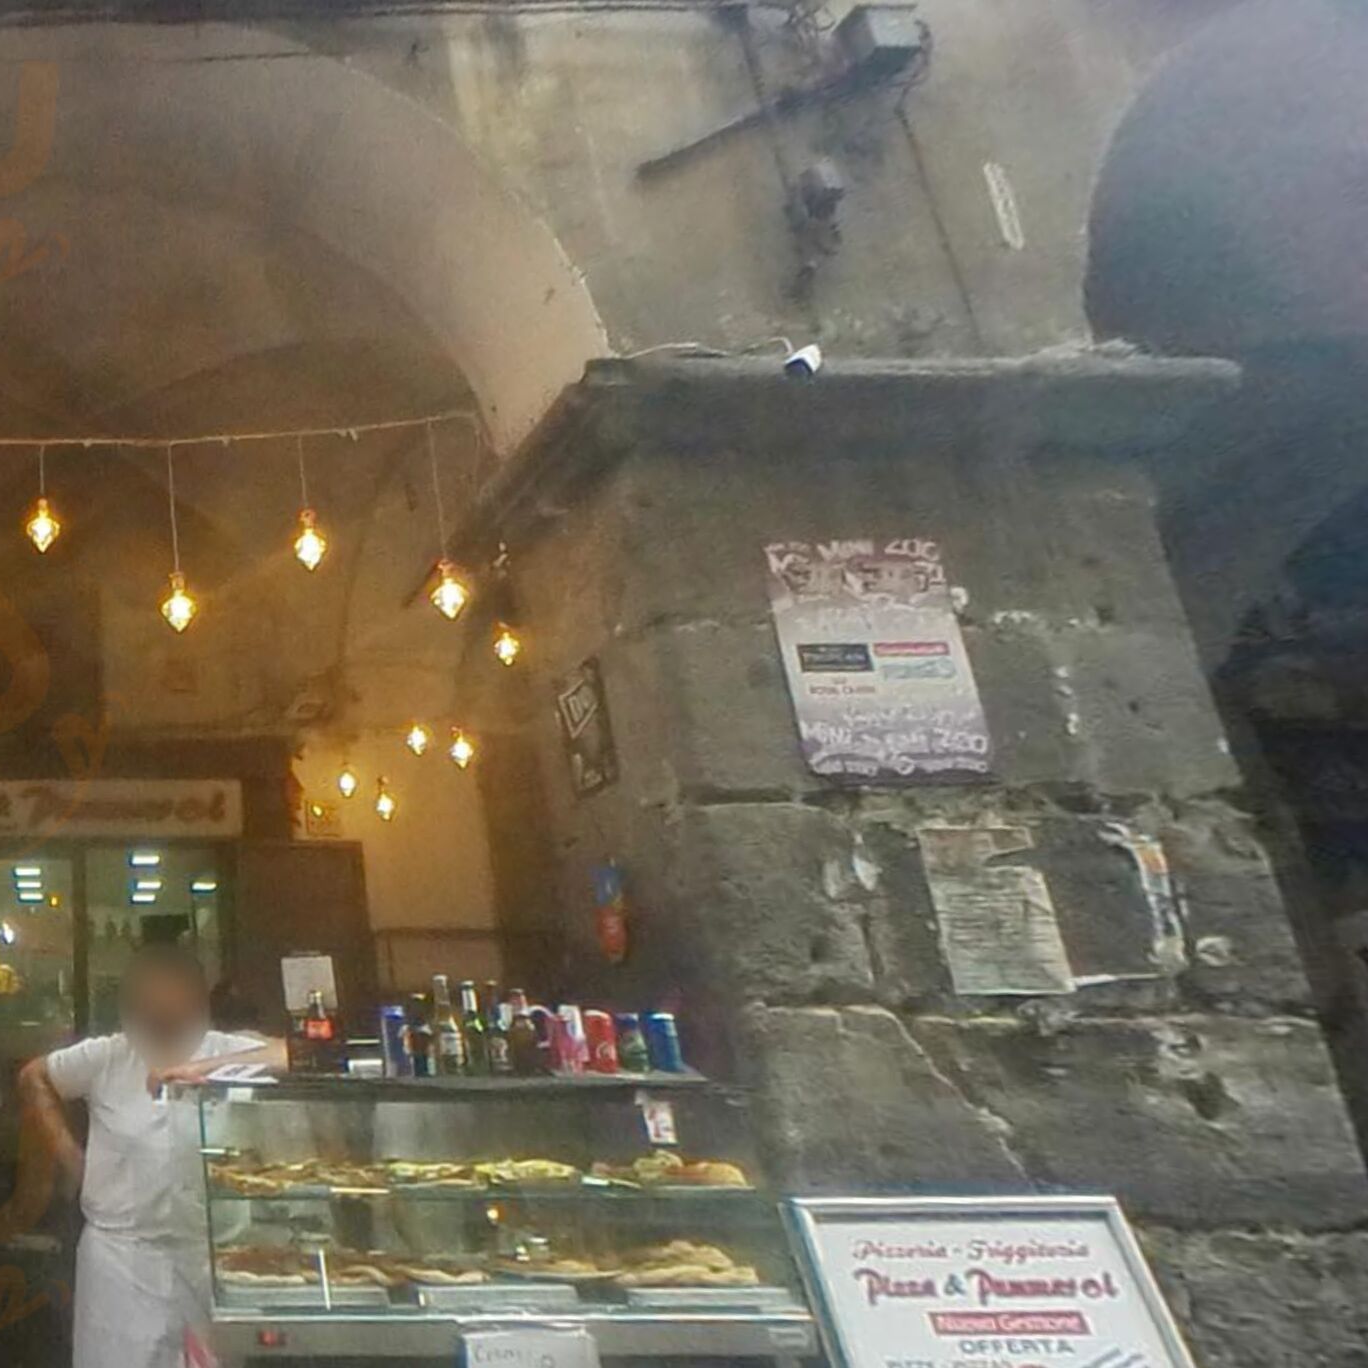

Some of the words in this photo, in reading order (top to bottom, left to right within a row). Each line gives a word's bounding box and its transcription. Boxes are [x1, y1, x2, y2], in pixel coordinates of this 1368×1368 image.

[853, 1267, 938, 1305] Pizza
[943, 1273, 965, 1296] &
[960, 1338, 1076, 1355] OFFERTA
